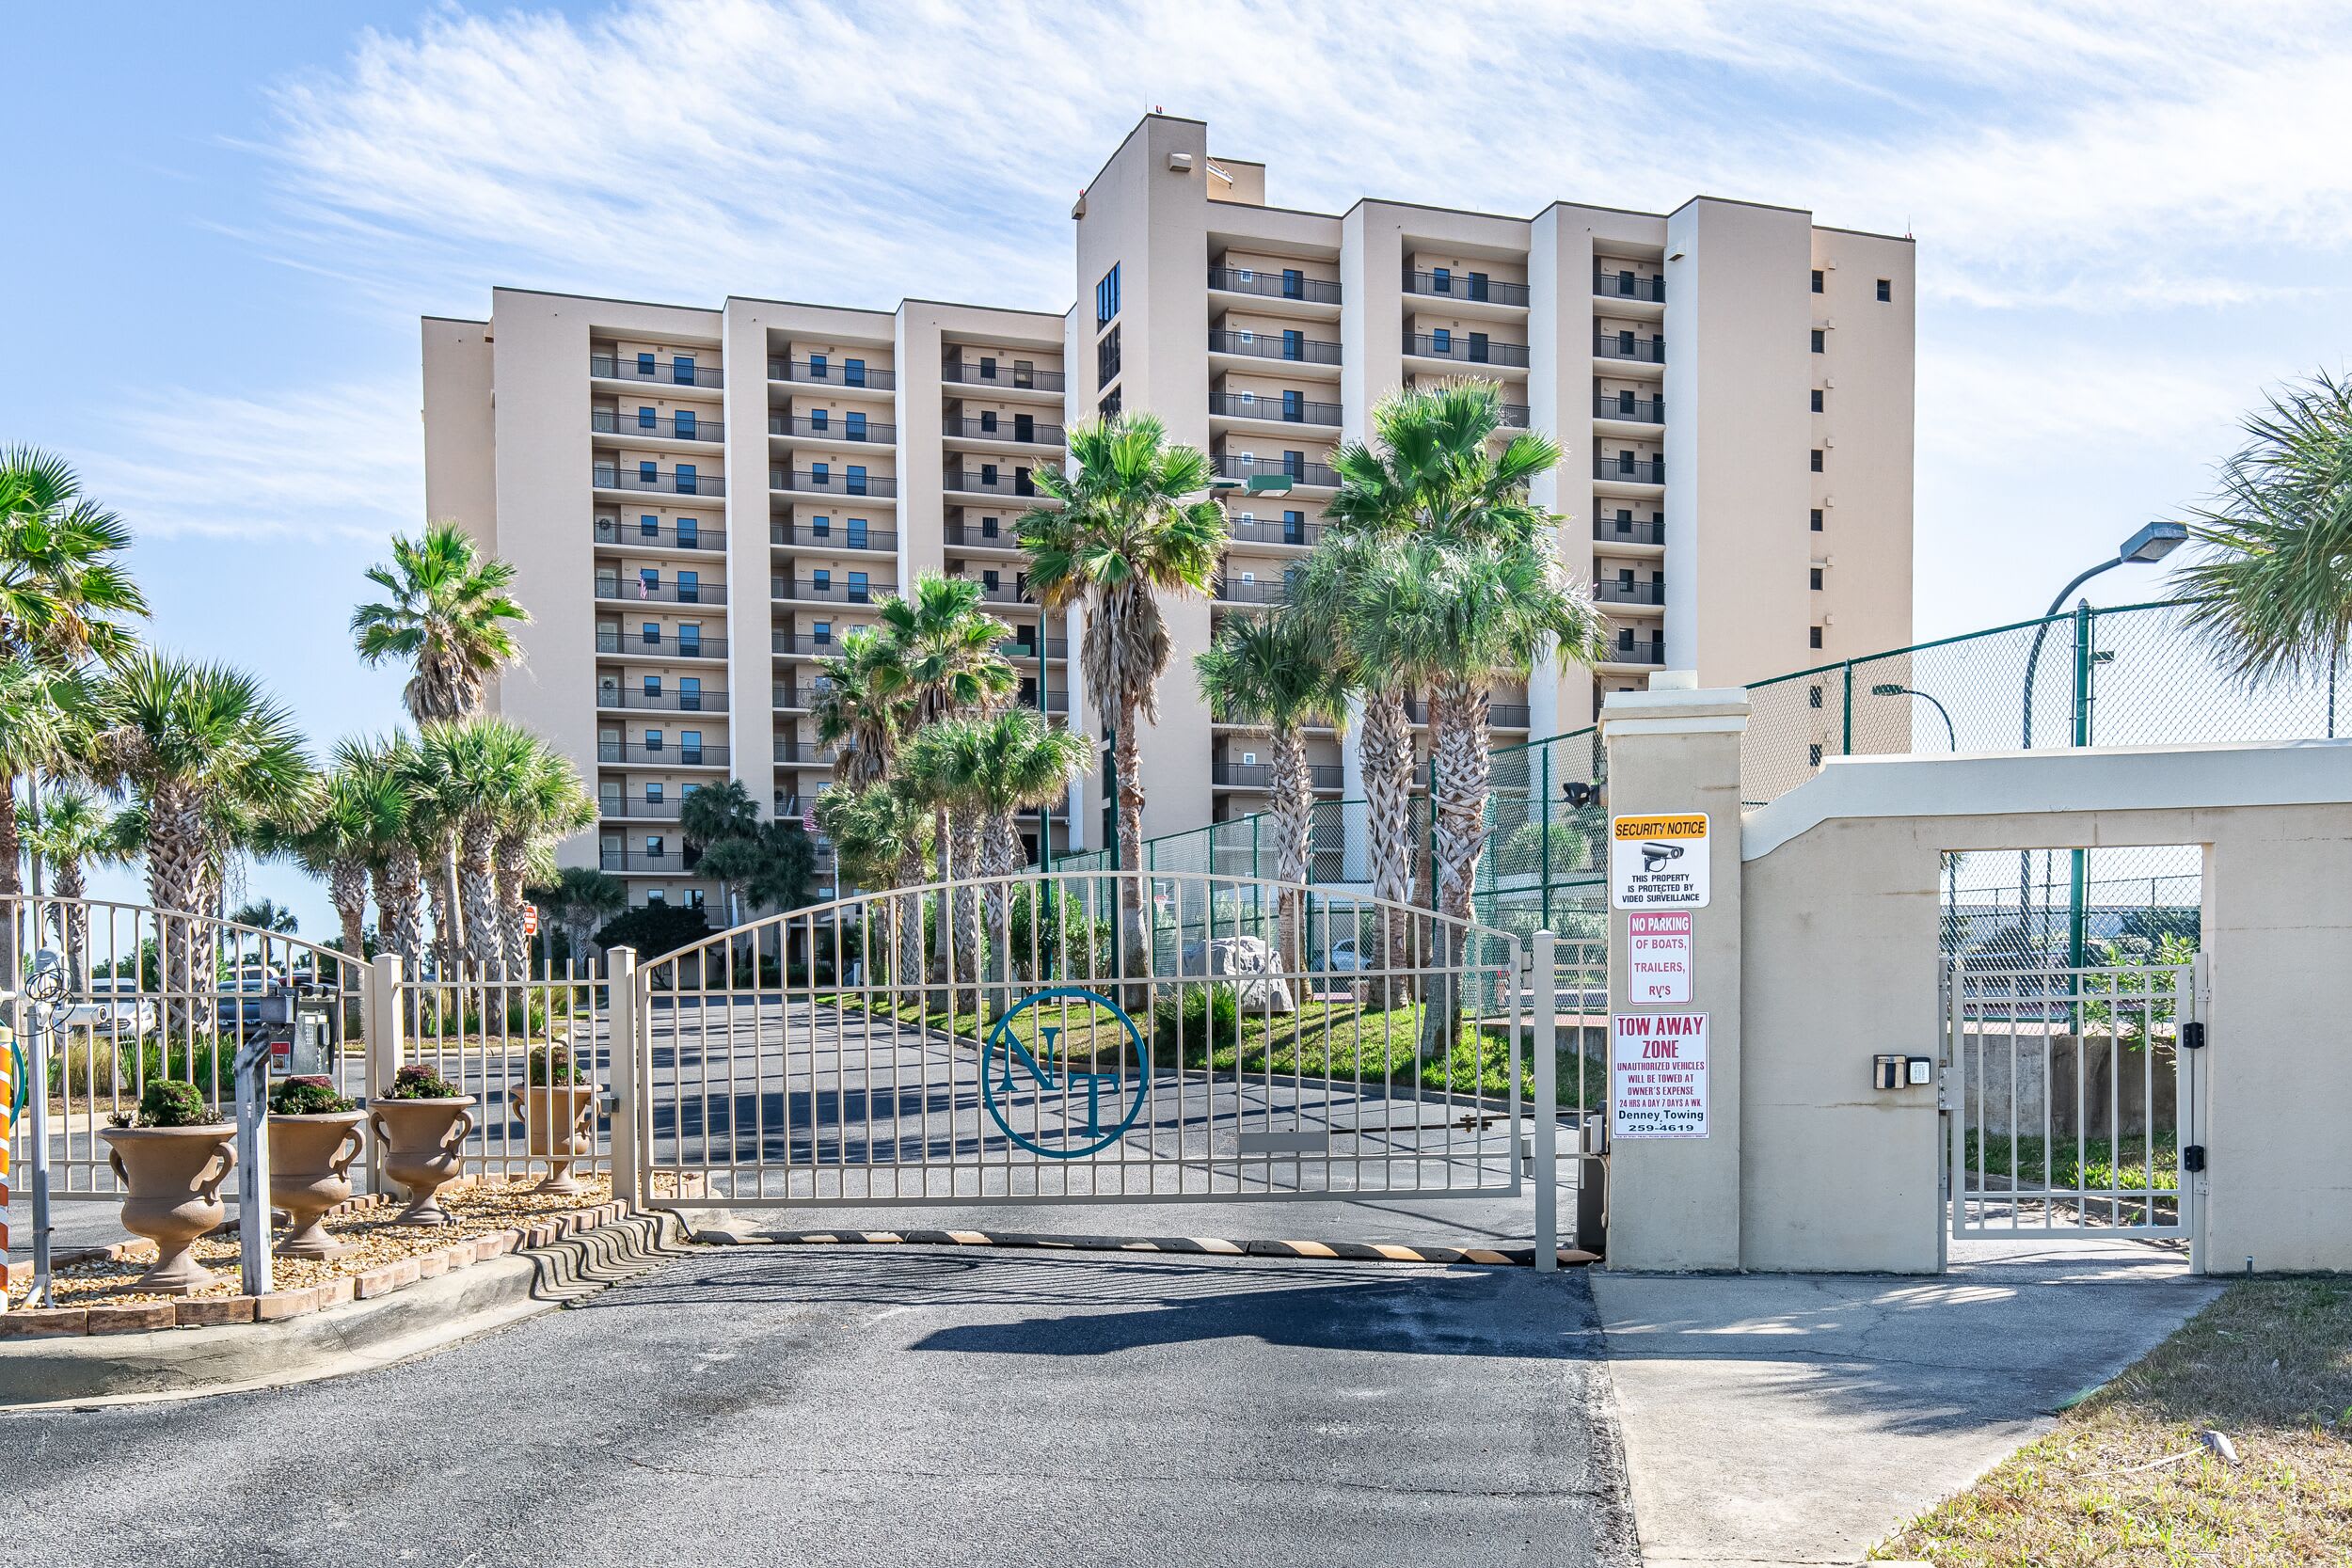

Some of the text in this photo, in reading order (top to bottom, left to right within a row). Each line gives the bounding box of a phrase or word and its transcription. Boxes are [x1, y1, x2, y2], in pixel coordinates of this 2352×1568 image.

[1615, 821, 1705, 836] SECURITY NOTICE
[1647, 893, 1700, 902] SURVEILLANCE
[1632, 917, 1689, 932] NO PARKING
[1636, 939, 1686, 950] OF BOATS,
[1634, 962, 1685, 974] TRAILERS,
[1649, 986, 1670, 995] RV'S
[1618, 1017, 1703, 1036] TOW AWAY
[1643, 1040, 1679, 1059] ZONE
[1618, 1061, 1704, 1071] UNAUTHORIZED VEHICLES
[1658, 1074, 1682, 1083] TOWED
[1628, 1086, 1694, 1095] OWNER'S EXPENSE
[1620, 1099, 1627, 1108] 24
[1629, 1099, 1640, 1108] HRS
[1662, 1099, 1666, 1107] 7
[1667, 1099, 1683, 1107] DAYS
[1619, 1109, 1703, 1121] Denney Towing
